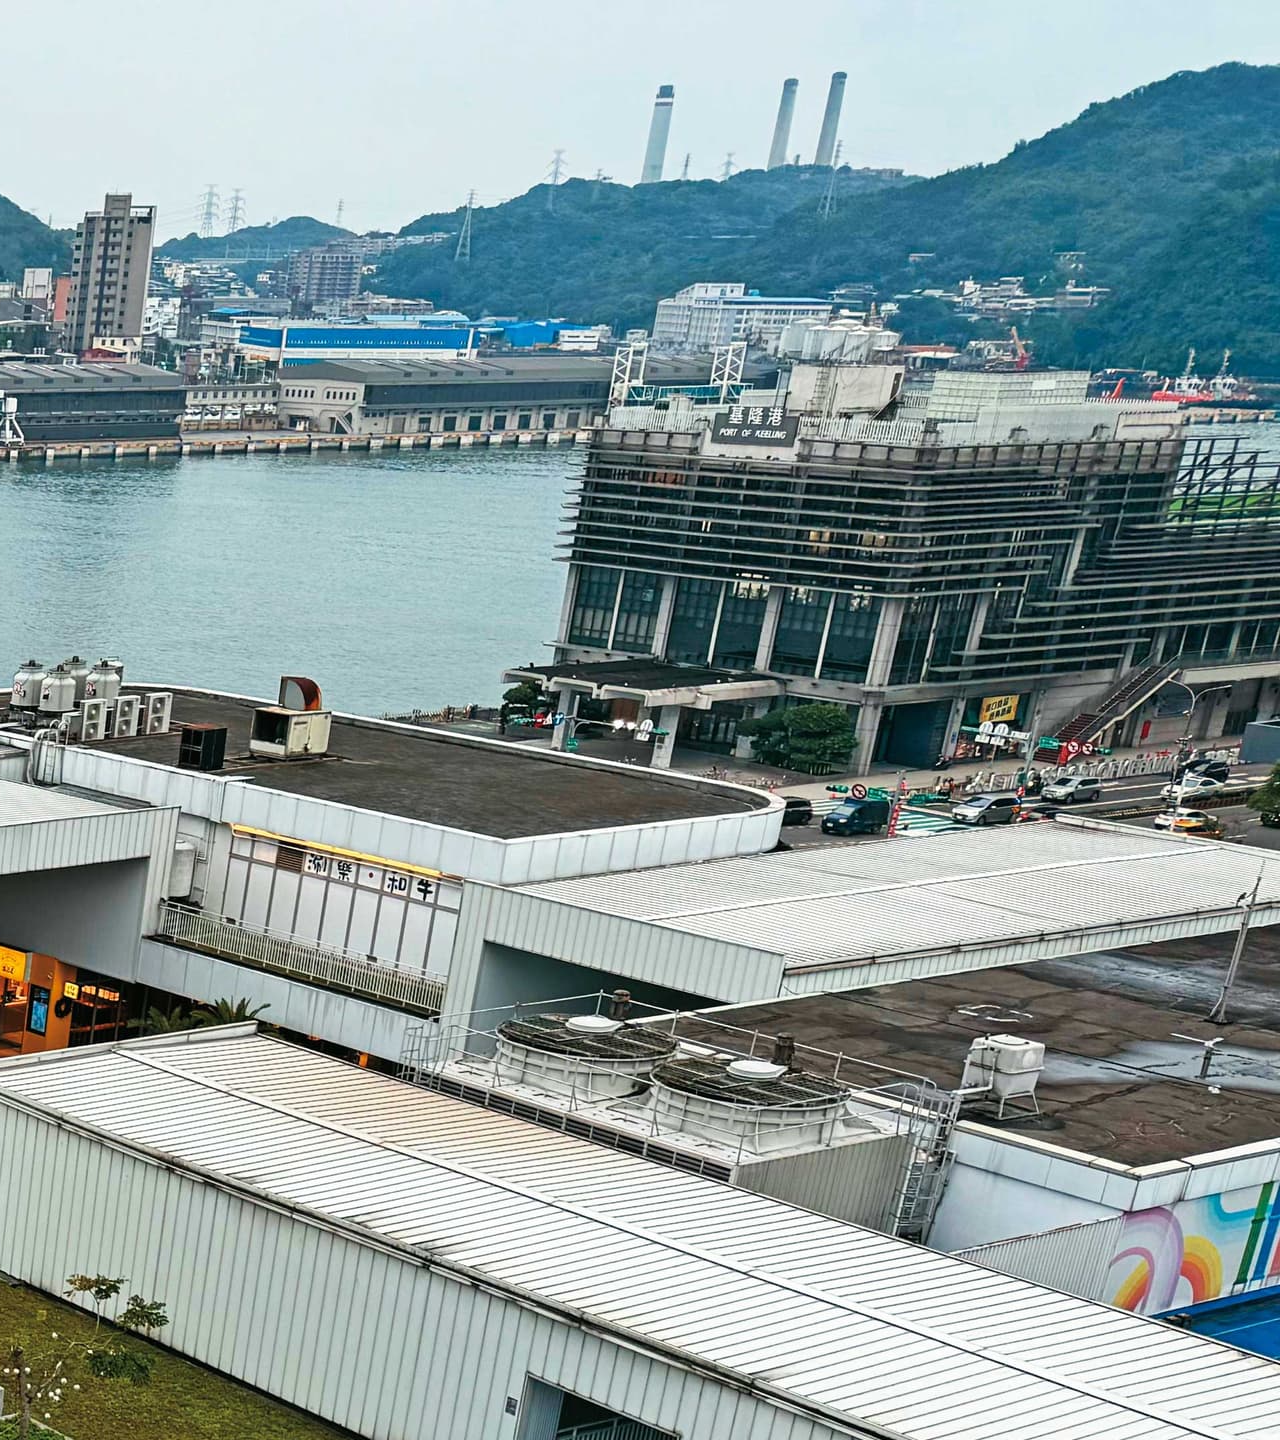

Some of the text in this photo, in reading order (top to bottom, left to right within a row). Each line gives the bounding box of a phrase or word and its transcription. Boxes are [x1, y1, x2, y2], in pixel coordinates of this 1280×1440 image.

[728, 406, 784, 426] 基隆港
[719, 427, 787, 439] PORT OF KEELUNG
